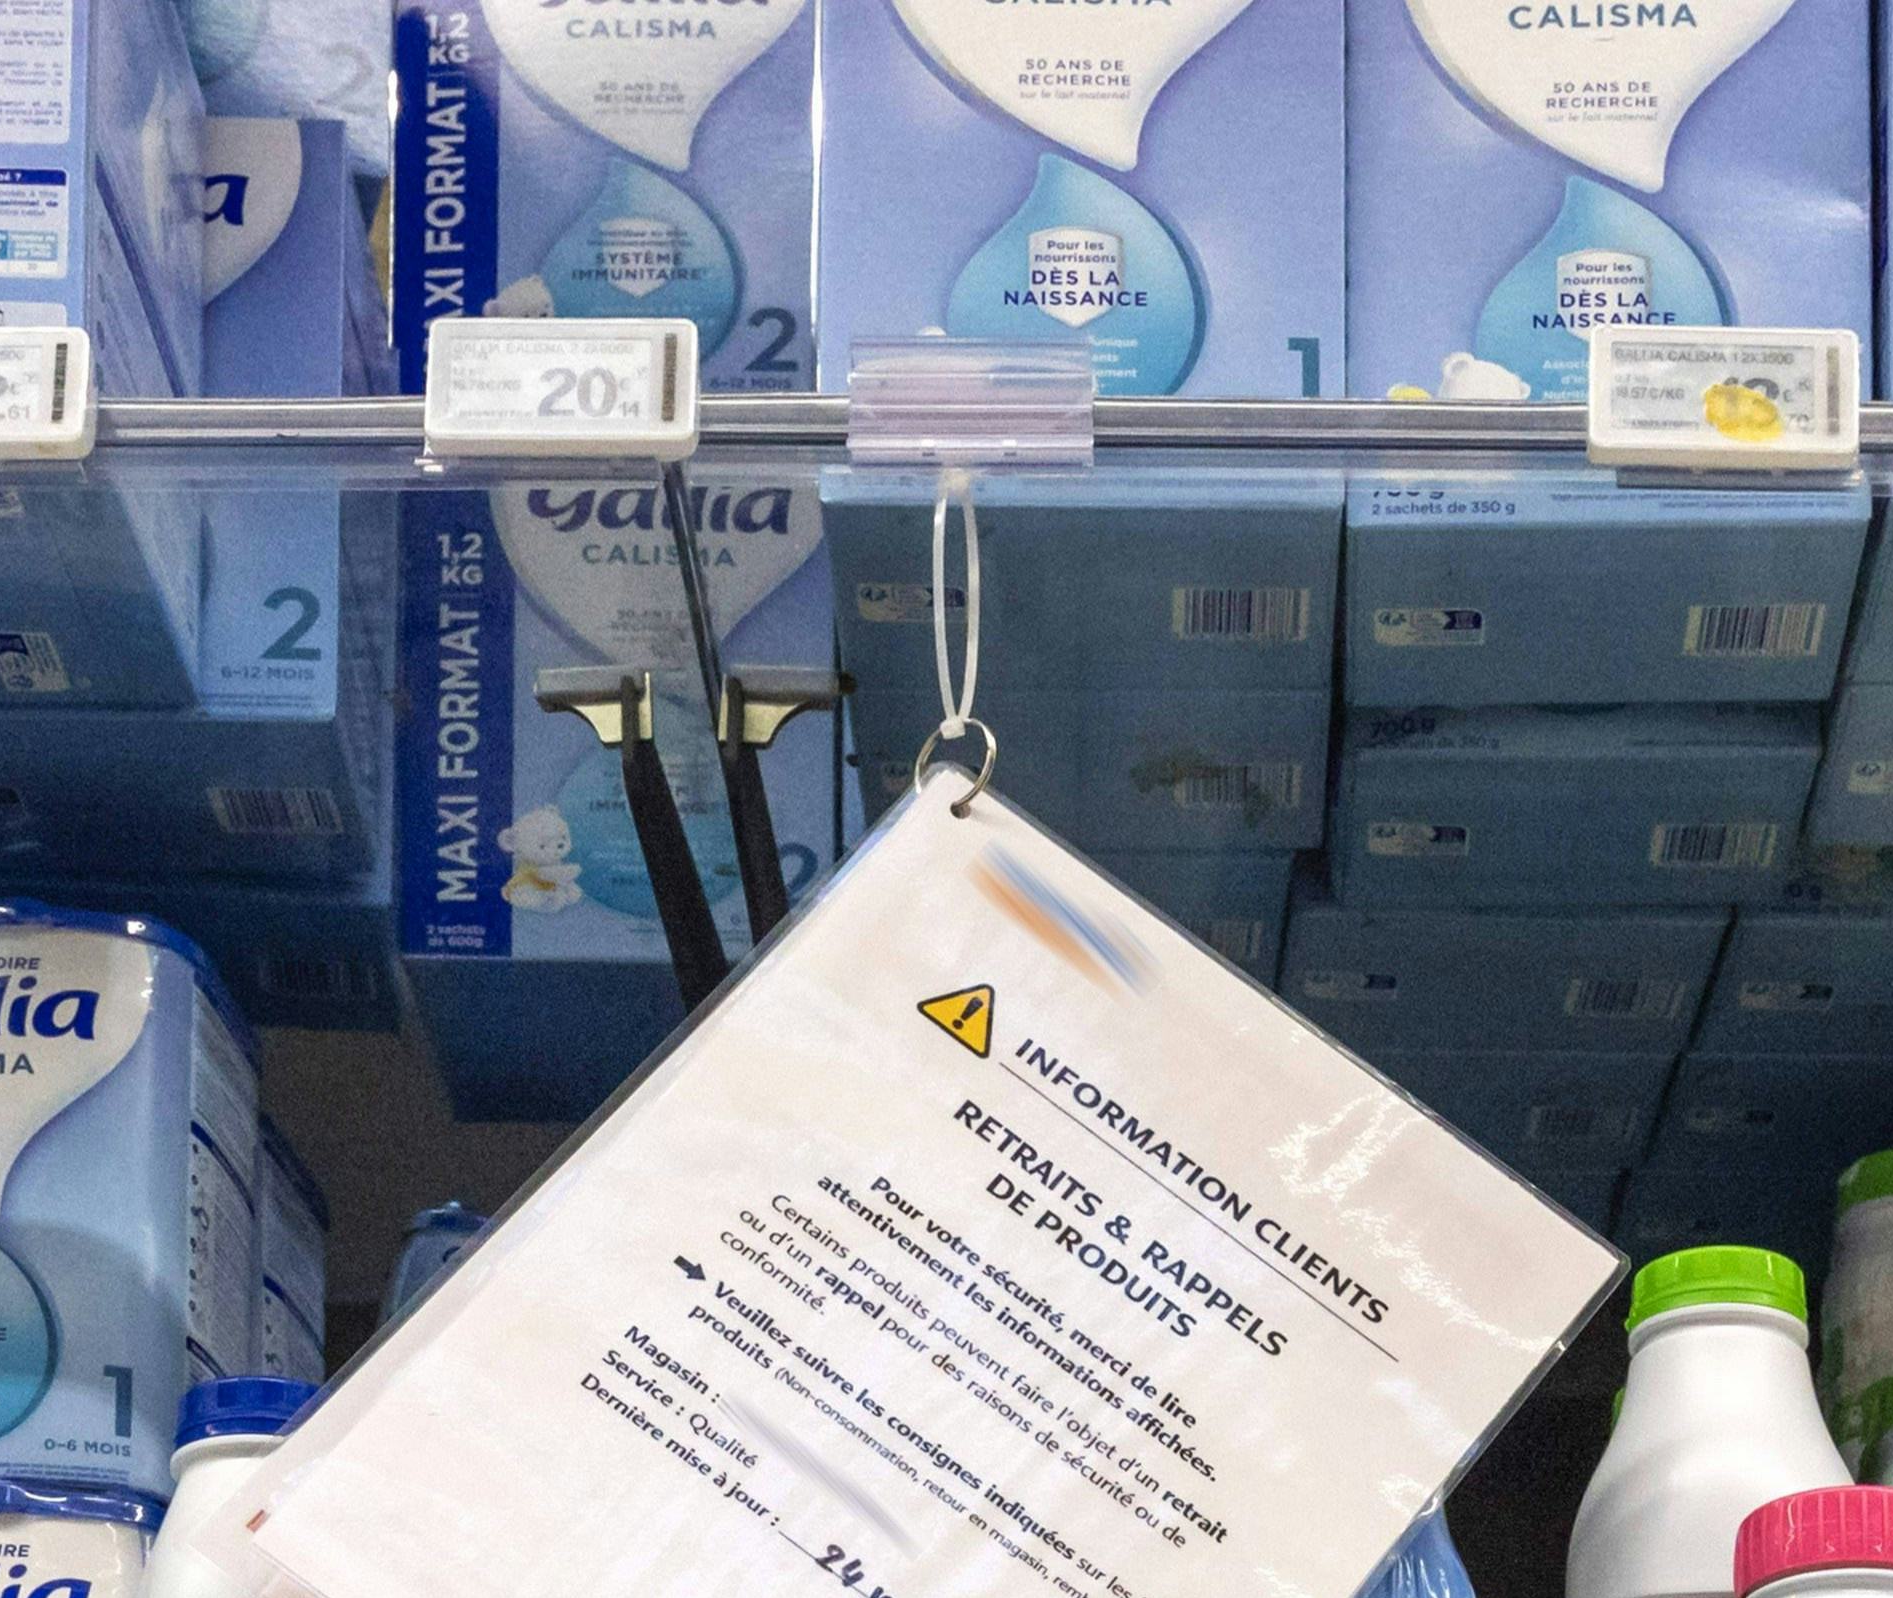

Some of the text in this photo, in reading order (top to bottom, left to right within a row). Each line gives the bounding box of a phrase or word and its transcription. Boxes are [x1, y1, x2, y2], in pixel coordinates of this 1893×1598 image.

[1507, 2, 1698, 33] CALISMA
[441, 564, 483, 587] KG
[1372, 501, 1516, 515] 2 sachets de 350 g
[437, 602, 480, 902] MAXI FORMAT
[719, 1230, 826, 1315] conformité.
[951, 1098, 1288, 1357] RETRAITS & RAPPELS
[984, 1172, 1197, 1338] DE PRODUITS
[1014, 1037, 1389, 1324] INFORMATION CLIENTS
[622, 1324, 709, 1395] Magasin
[738, 1209, 1186, 1548] ou d'un rappel pour des raisons de sécurité ou de
[770, 1193, 1228, 1544] Certains produits peuvent faire l'objet d'un retrait
[816, 1175, 1216, 1482] attentivement les informations affichées.
[869, 1175, 1197, 1429] Pour votre sécurité, merci de lire
[579, 1371, 665, 1441] Dernière
[664, 1438, 712, 1476] mise
[711, 1470, 728, 1489] à
[722, 1481, 770, 1517] jour
[600, 1348, 674, 1408] Service
[687, 1412, 758, 1469] Qualité
[687, 1304, 773, 1370] produits
[773, 1366, 918, 1482] (Non-consommation,
[922, 1478, 967, 1513] retour
[967, 1512, 988, 1531] en
[987, 1527, 1049, 1580] magasin,
[713, 1279, 793, 1349] Veuillez
[791, 1344, 854, 1395] suivre
[854, 1387, 886, 1418] les
[885, 1415, 983, 1490] consignes
[983, 1482, 1076, 1560] indiquées
[1075, 1557, 1107, 1580] sur
[811, 1542, 865, 1591] 24
